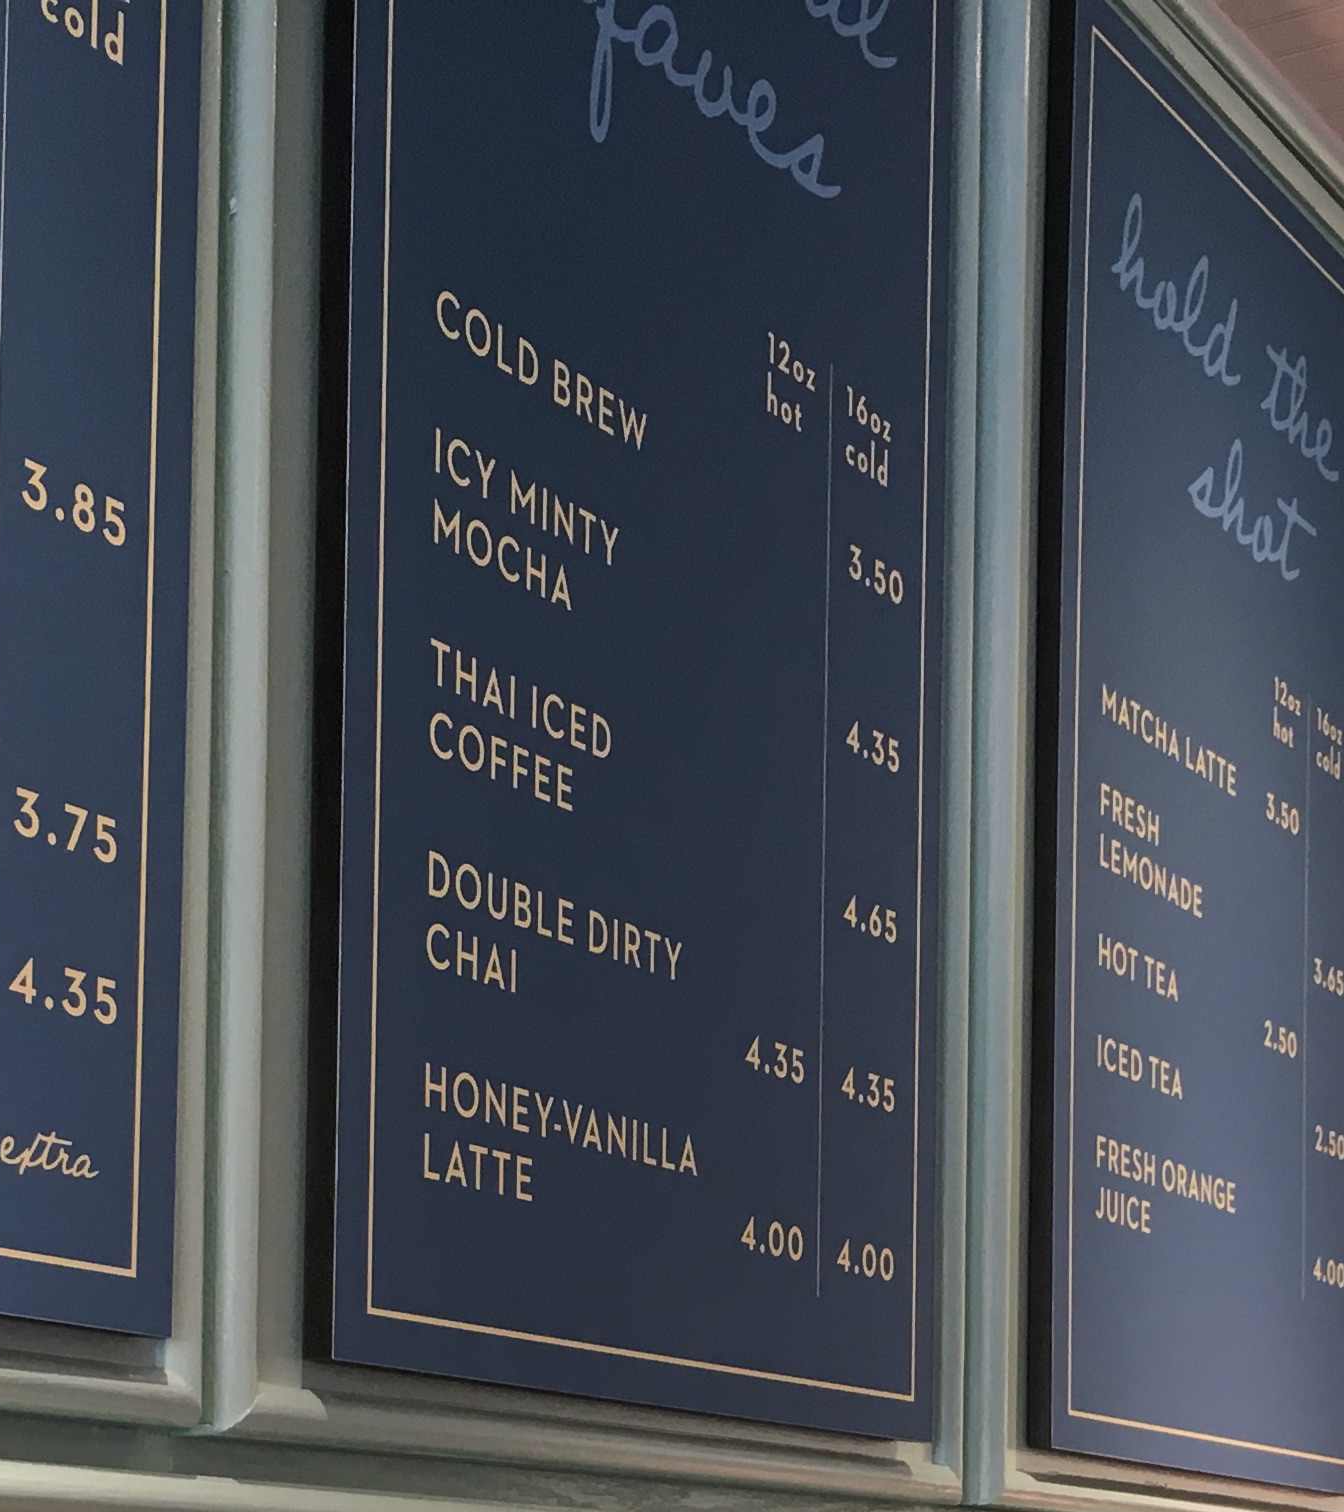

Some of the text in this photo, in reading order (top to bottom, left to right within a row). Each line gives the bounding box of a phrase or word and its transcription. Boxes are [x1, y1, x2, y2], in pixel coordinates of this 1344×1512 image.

[42, 0, 124, 65] cold
[767, 331, 816, 393] 12oz
[1111, 193, 1339, 482] hold the
[436, 291, 648, 451] COLD BREW
[767, 371, 802, 433] hot
[846, 385, 892, 443] 16oz
[434, 428, 619, 567] ICY MINTY
[845, 441, 888, 488] cold
[21, 458, 126, 546] 3.85
[1187, 438, 1317, 581] shot
[433, 497, 572, 612] MOCHA
[848, 544, 904, 605] 3.50
[430, 637, 612, 759] THAI ICED
[1273, 705, 1294, 748] hot
[1274, 676, 1301, 716] 12oz
[1317, 707, 1343, 746] 16oz
[429, 711, 573, 812] COFFEE
[845, 721, 900, 773] 4.35
[1101, 683, 1237, 797] MATCHA LATTE
[1316, 745, 1341, 780] cold
[14, 786, 118, 863] 3.75
[1100, 783, 1160, 847] FRESH
[1266, 791, 1299, 836] 3.50
[1099, 833, 1203, 919] LEMONADE
[428, 849, 683, 982] DOUBLE DIRTY
[842, 894, 898, 944] 4.65
[9, 957, 118, 1026] 4.35
[425, 923, 517, 994] CHAI
[1098, 933, 1179, 1002] HOT TEA
[1313, 957, 1344, 997] 3.65
[1097, 1034, 1182, 1100] ICED TEA
[1263, 1020, 1297, 1059] 2.50
[745, 1035, 895, 1114] 4.35 4.35
[424, 1062, 698, 1177] HONEY-VANILLA
[0, 1131, 99, 1178] extra
[423, 1132, 533, 1202] LATTE
[1095, 1135, 1236, 1213] FRESH ORANGE
[1095, 1187, 1151, 1235] JUICE
[740, 1216, 894, 1281] 4.00 4.00
